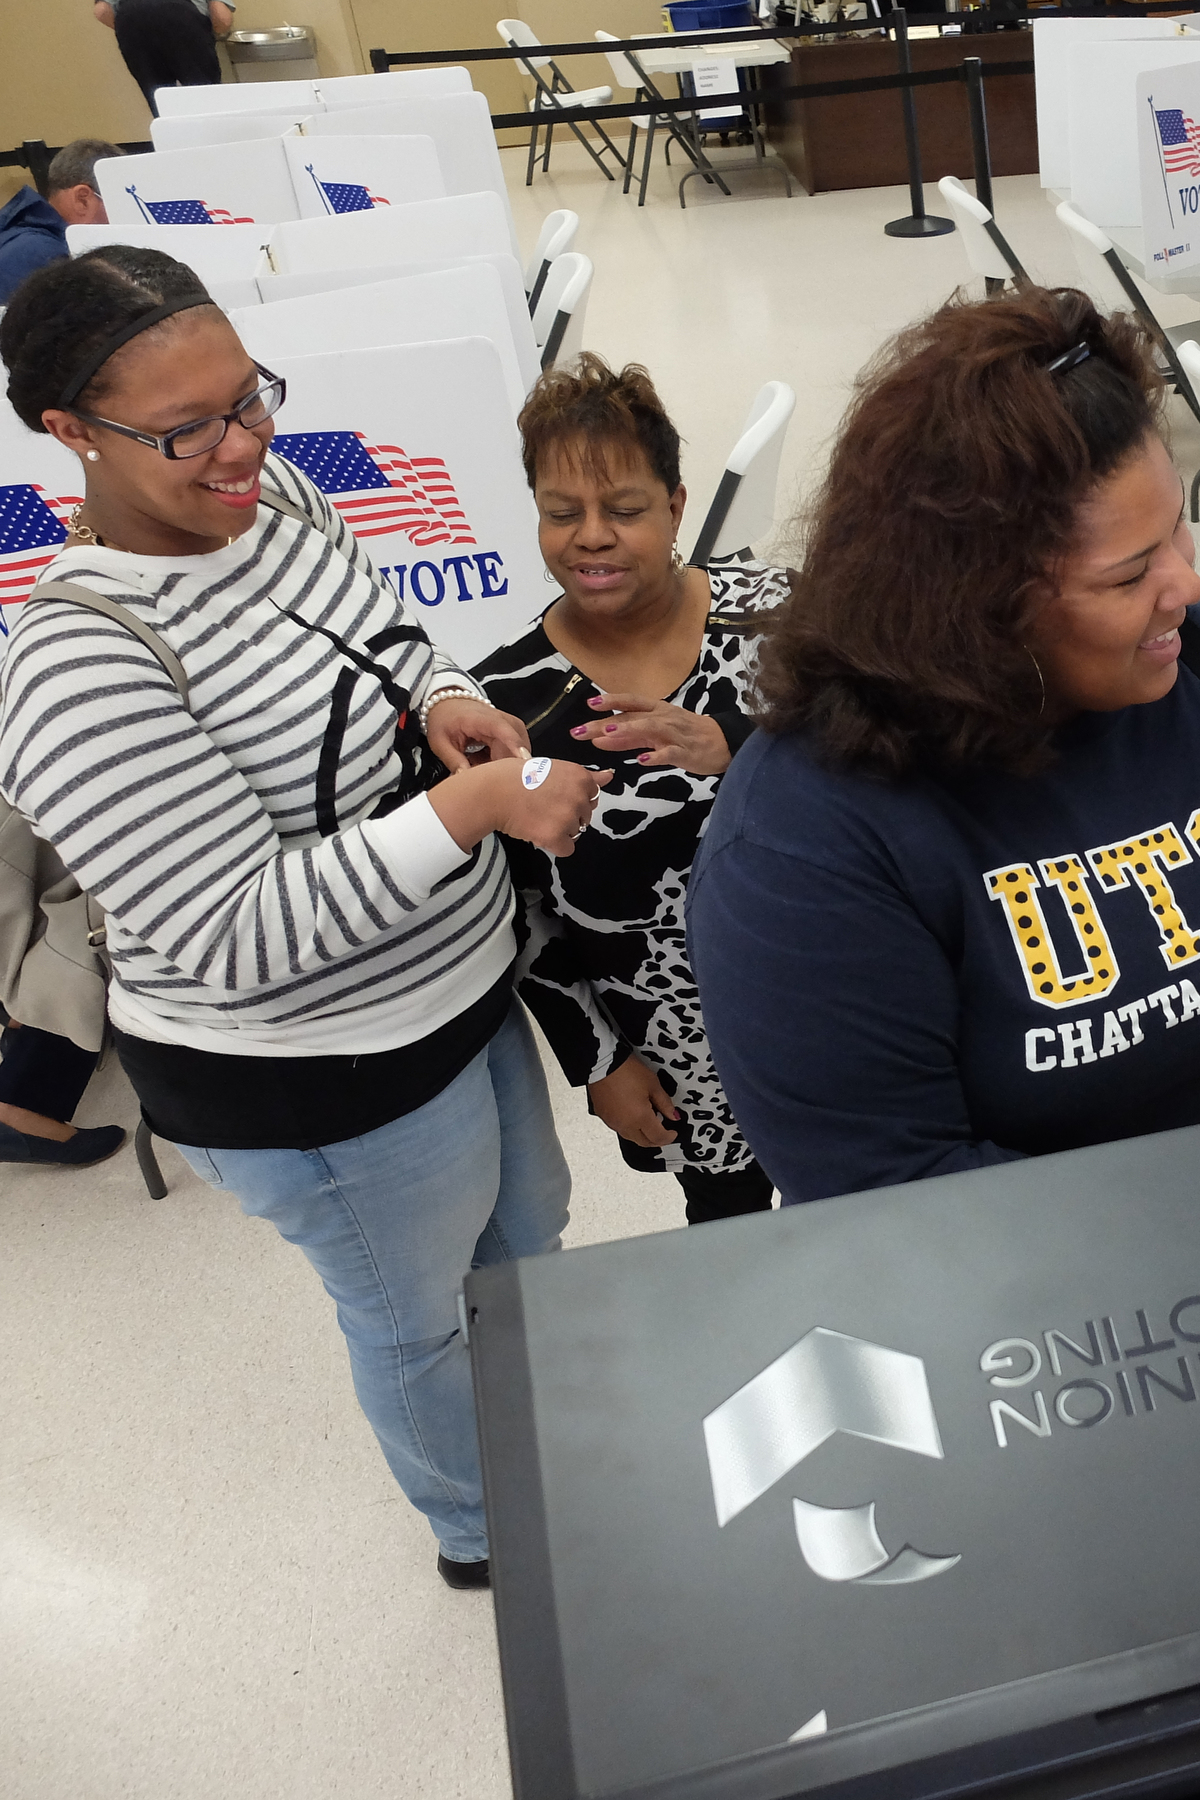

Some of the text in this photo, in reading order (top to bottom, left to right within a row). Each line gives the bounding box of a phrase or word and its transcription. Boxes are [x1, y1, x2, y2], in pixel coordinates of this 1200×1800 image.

[1153, 252, 1165, 262] POLL
[1168, 245, 1184, 257] MASTER
[378, 551, 508, 607] VOTE
